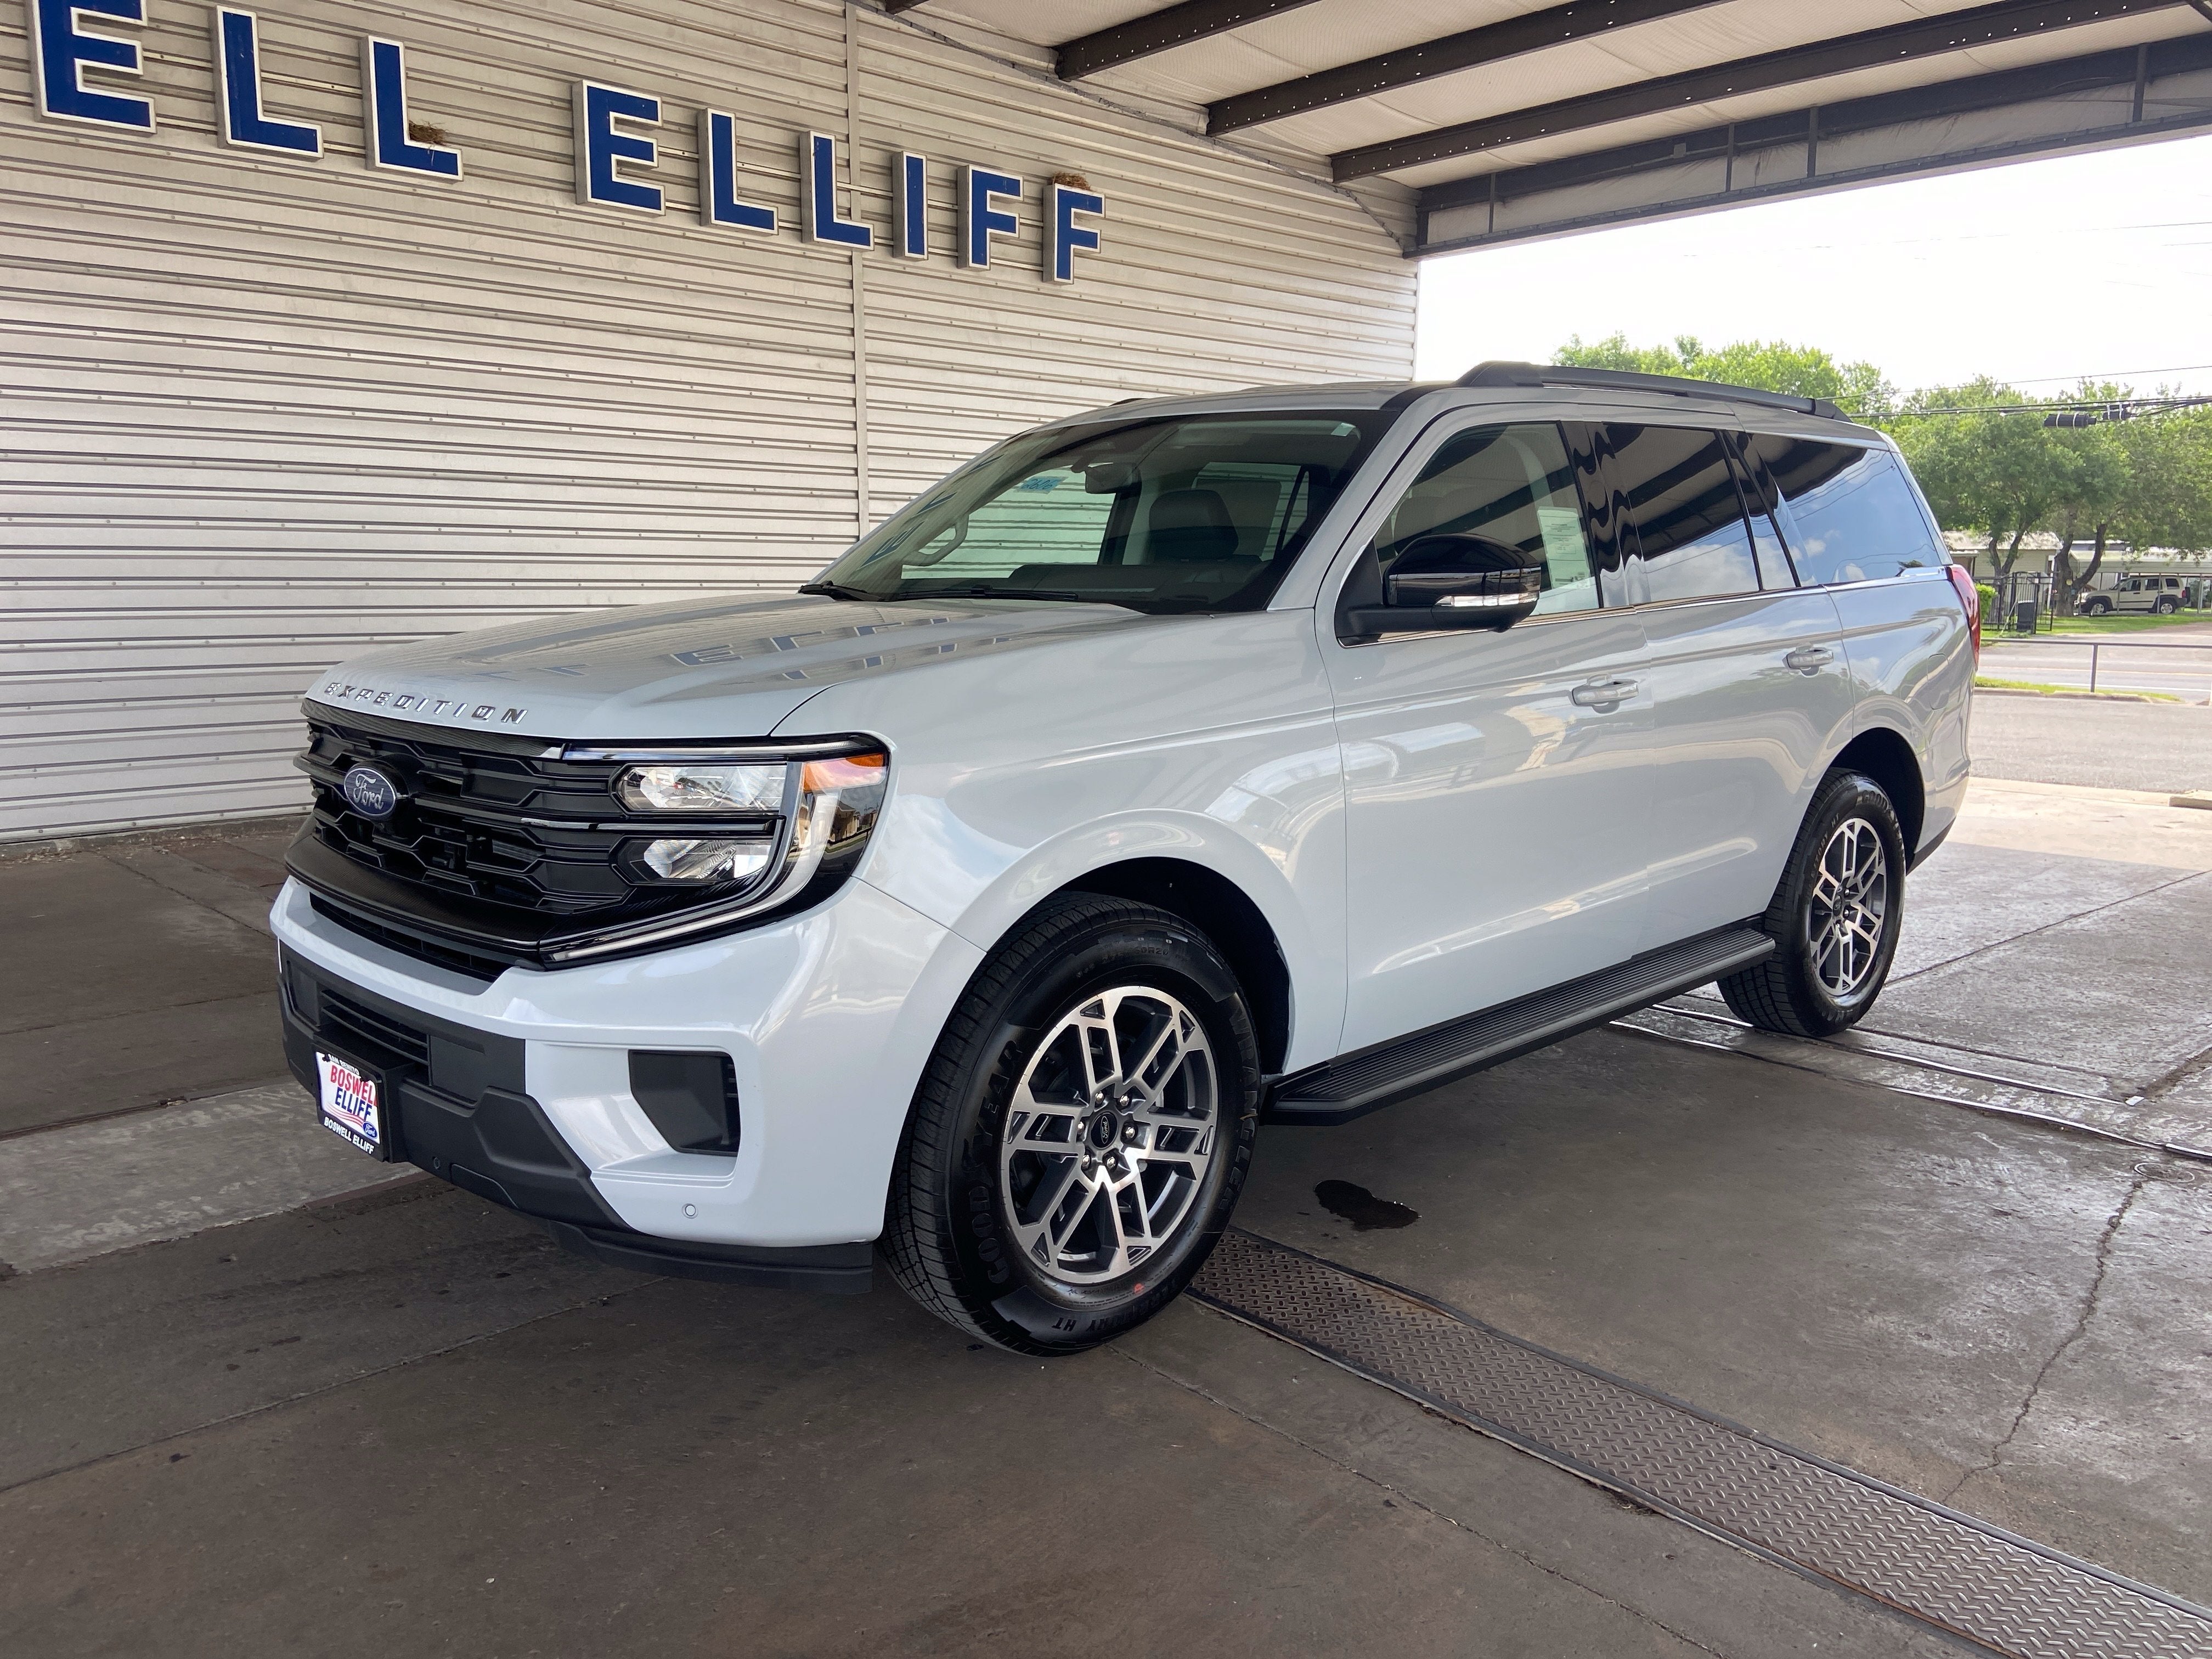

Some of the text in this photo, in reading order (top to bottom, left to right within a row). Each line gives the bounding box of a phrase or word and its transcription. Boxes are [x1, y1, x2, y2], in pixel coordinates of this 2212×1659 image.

[573, 80, 1105, 284] ELLIFF
[324, 682, 528, 725] EXPEDITION
[353, 773, 384, 810] Ford
[335, 1087, 373, 1121] ELLIFF
[324, 1116, 374, 1154] BOSWELL ELLIFF
[1052, 1317, 1076, 1332] HT
